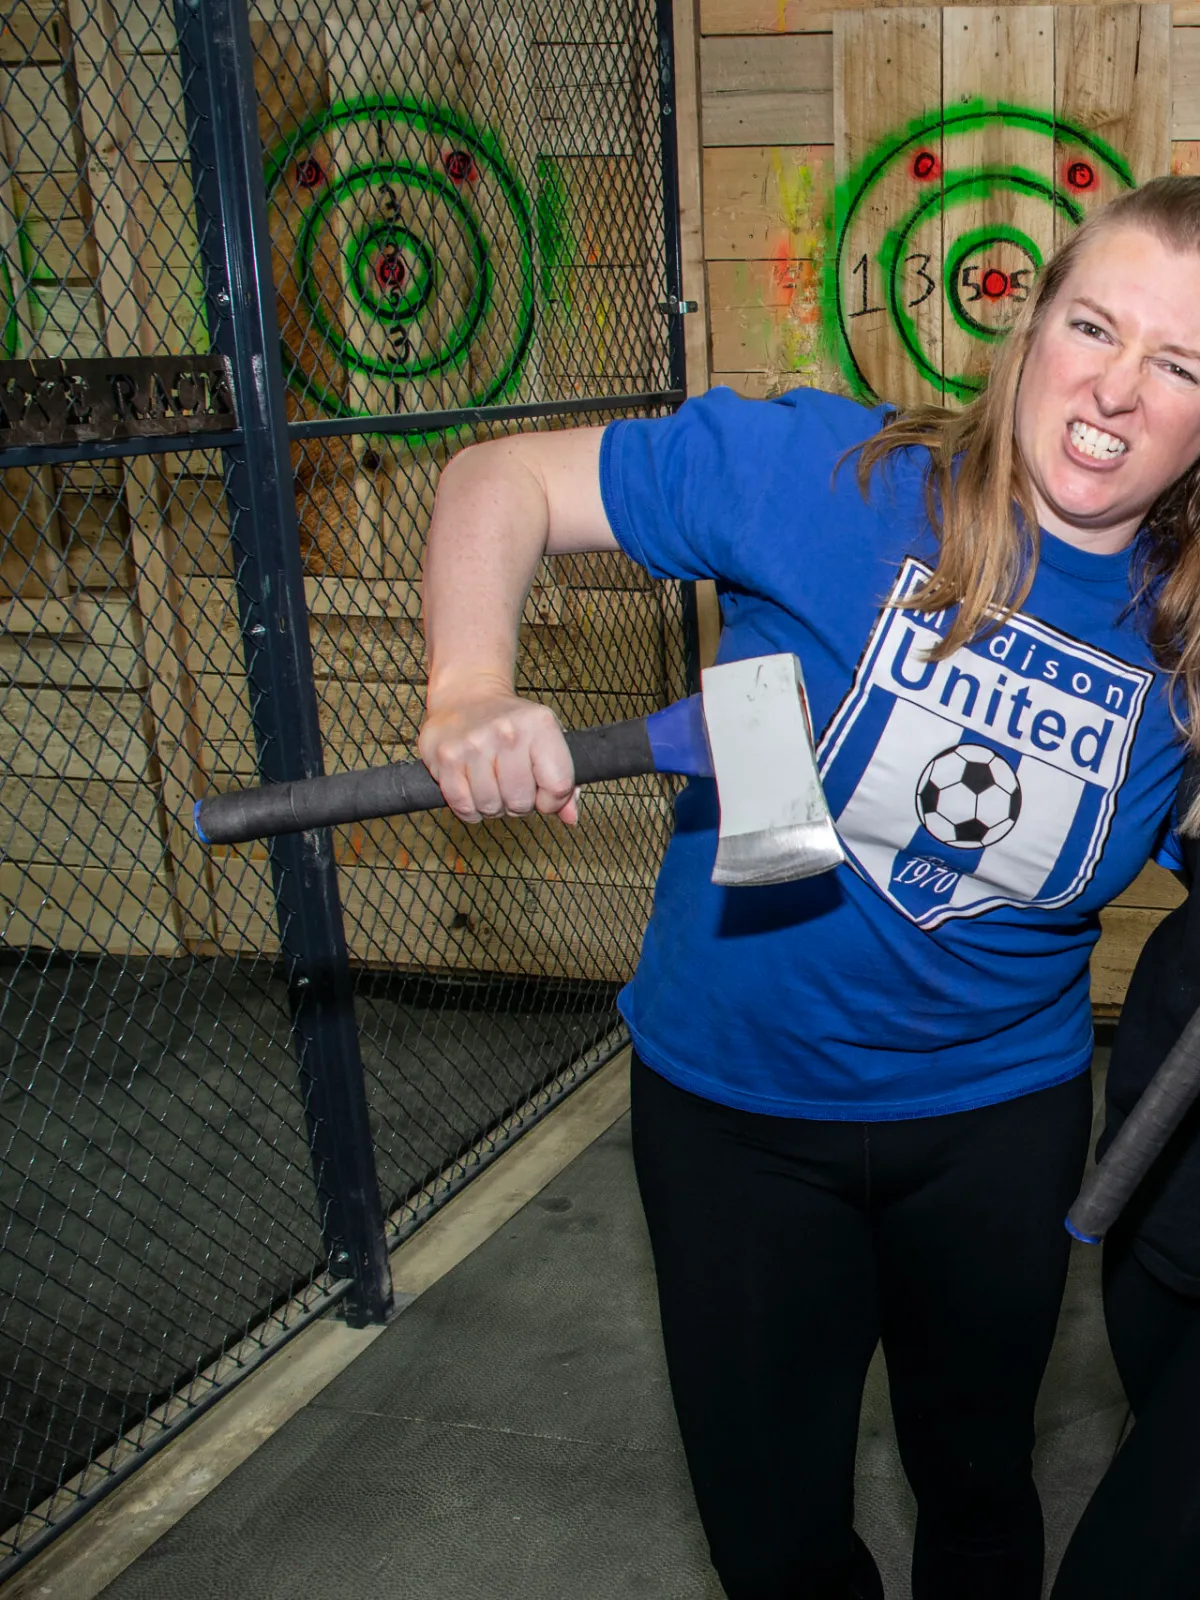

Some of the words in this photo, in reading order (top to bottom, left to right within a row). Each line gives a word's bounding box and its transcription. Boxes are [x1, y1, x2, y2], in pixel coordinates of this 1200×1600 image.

[848, 253, 887, 318] 1
[904, 253, 935, 307] 3
[962, 265, 982, 302] 5
[1009, 269, 1032, 302] 5
[0, 374, 92, 429] XE
[106, 371, 231, 421] RACK
[913, 604, 1124, 710] Mdison
[890, 626, 1115, 774] United
[893, 860, 959, 893] 1970
